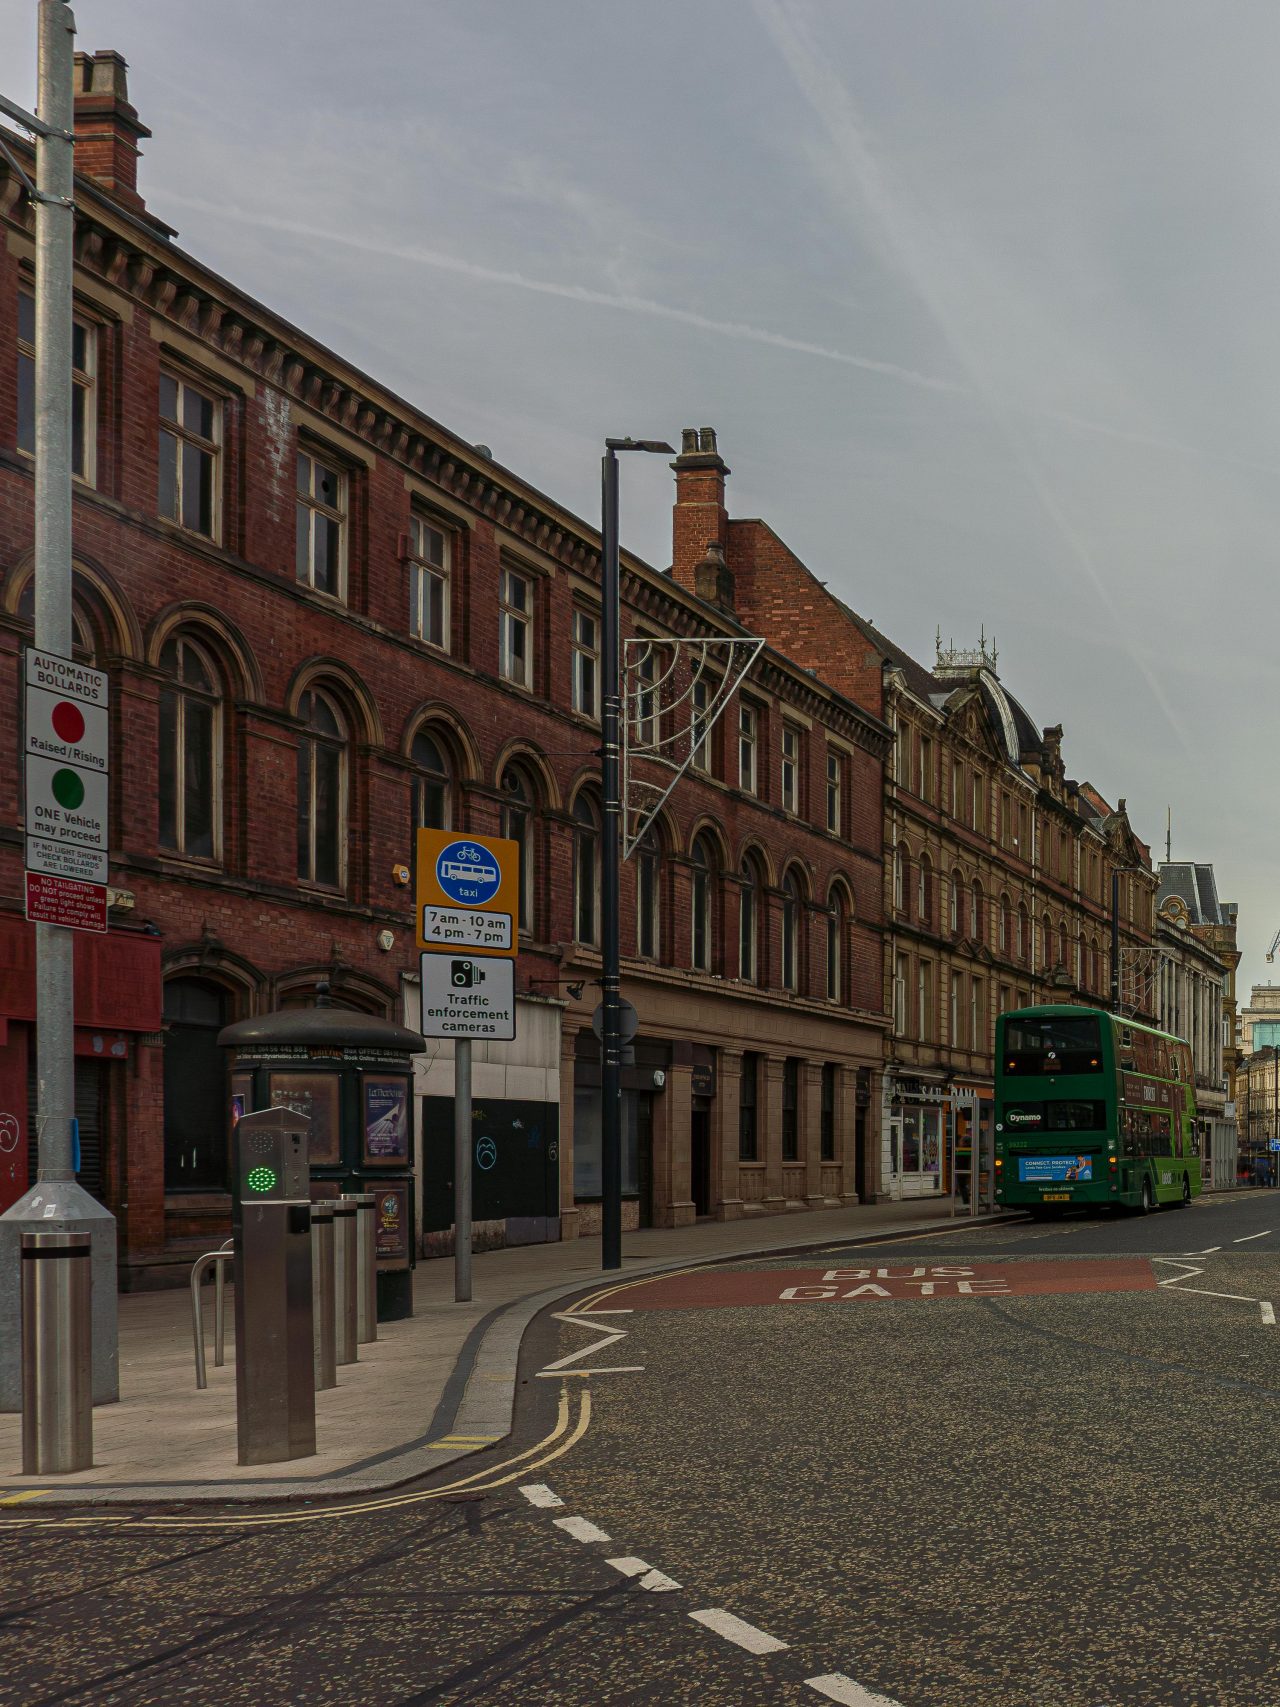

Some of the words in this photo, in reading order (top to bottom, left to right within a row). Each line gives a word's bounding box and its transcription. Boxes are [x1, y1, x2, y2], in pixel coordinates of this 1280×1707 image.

[34, 657, 102, 687] AUTOMATIC
[37, 671, 98, 699] BOLLARDS
[31, 737, 66, 755] Raised
[74, 748, 105, 768] Rising
[34, 805, 61, 821] ONE
[64, 812, 101, 830] Vehicle
[34, 821, 57, 835] may
[60, 827, 101, 844] proceed
[36, 851, 62, 862] CHECK
[63, 856, 99, 869] BOLLARDS
[41, 843, 53, 852] NO
[54, 846, 75, 857] LIGHT
[77, 849, 103, 862] SHOWS
[43, 860, 58, 869] ARE
[59, 863, 93, 876] LOWERED
[29, 884, 41, 893] DO
[42, 885, 58, 895] NOT
[40, 877, 52, 886] NO
[53, 879, 95, 894] TAILGATING
[459, 887, 478, 898] taxi
[429, 911, 438, 922] 7
[440, 915, 459, 925] am
[469, 915, 485, 928] 10
[487, 920, 506, 930] am
[431, 925, 441, 936] 4
[444, 929, 464, 940] pm
[474, 930, 482, 941] 7
[484, 932, 503, 943] pm
[447, 993, 489, 1006] Traffic
[427, 1008, 509, 1021] enforcement
[442, 1021, 496, 1033] cameras
[1010, 1113, 1042, 1122] Dynamo
[822, 1266, 975, 1281] BUS
[778, 1279, 1012, 1300] GATE
